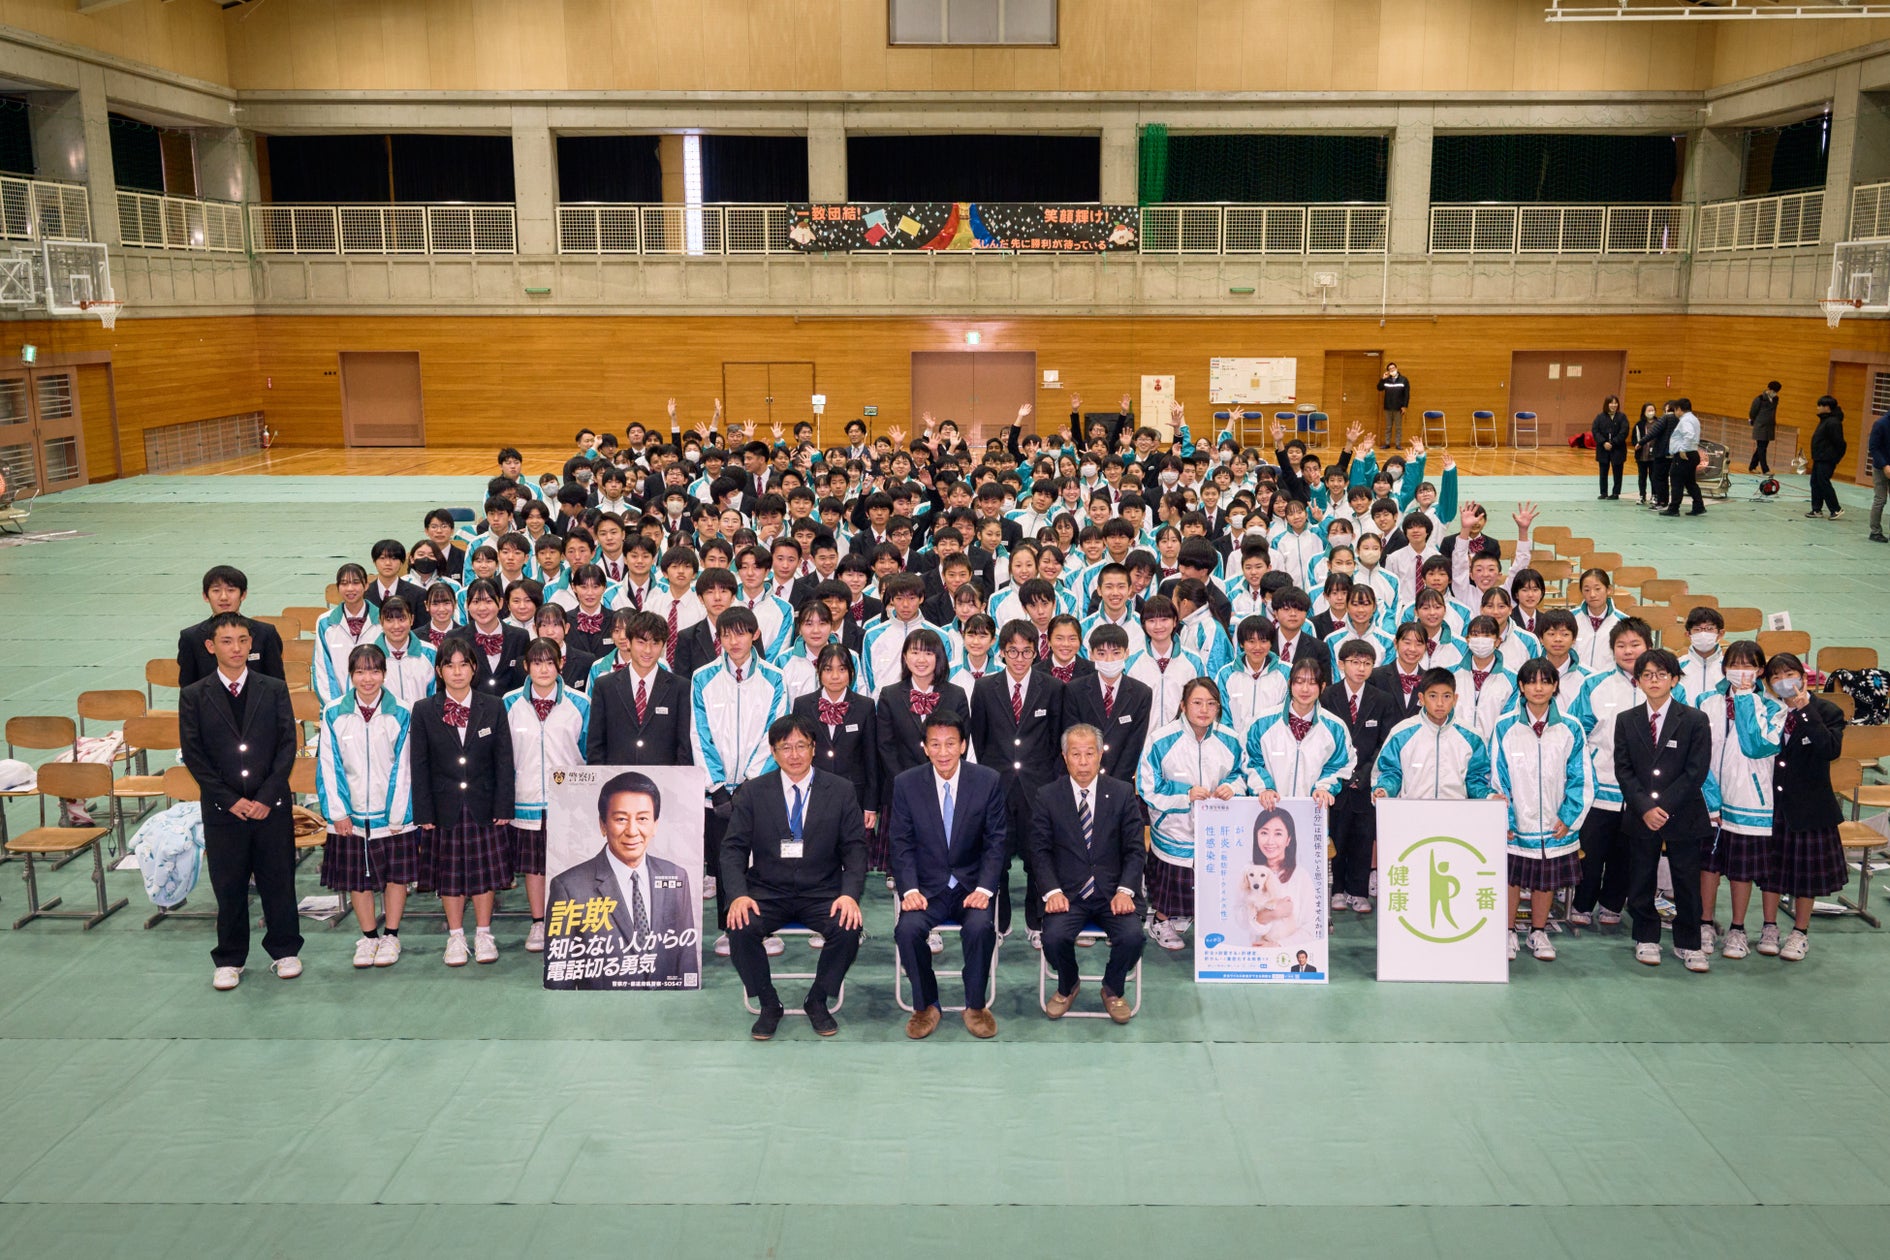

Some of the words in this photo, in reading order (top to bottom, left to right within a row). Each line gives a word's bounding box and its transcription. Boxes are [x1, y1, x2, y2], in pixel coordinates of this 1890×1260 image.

[797, 206, 862, 221] 一致団結!
[1044, 208, 1109, 224] 笑顔輝け!
[1205, 825, 1216, 873] 性感染症
[1235, 825, 1245, 848] がん
[1387, 864, 1410, 912] 健康
[1475, 870, 1498, 911] 一番
[548, 896, 618, 937] 詐欺
[547, 928, 698, 961] 知らない人からの
[546, 953, 658, 982] 電話切る勇気
